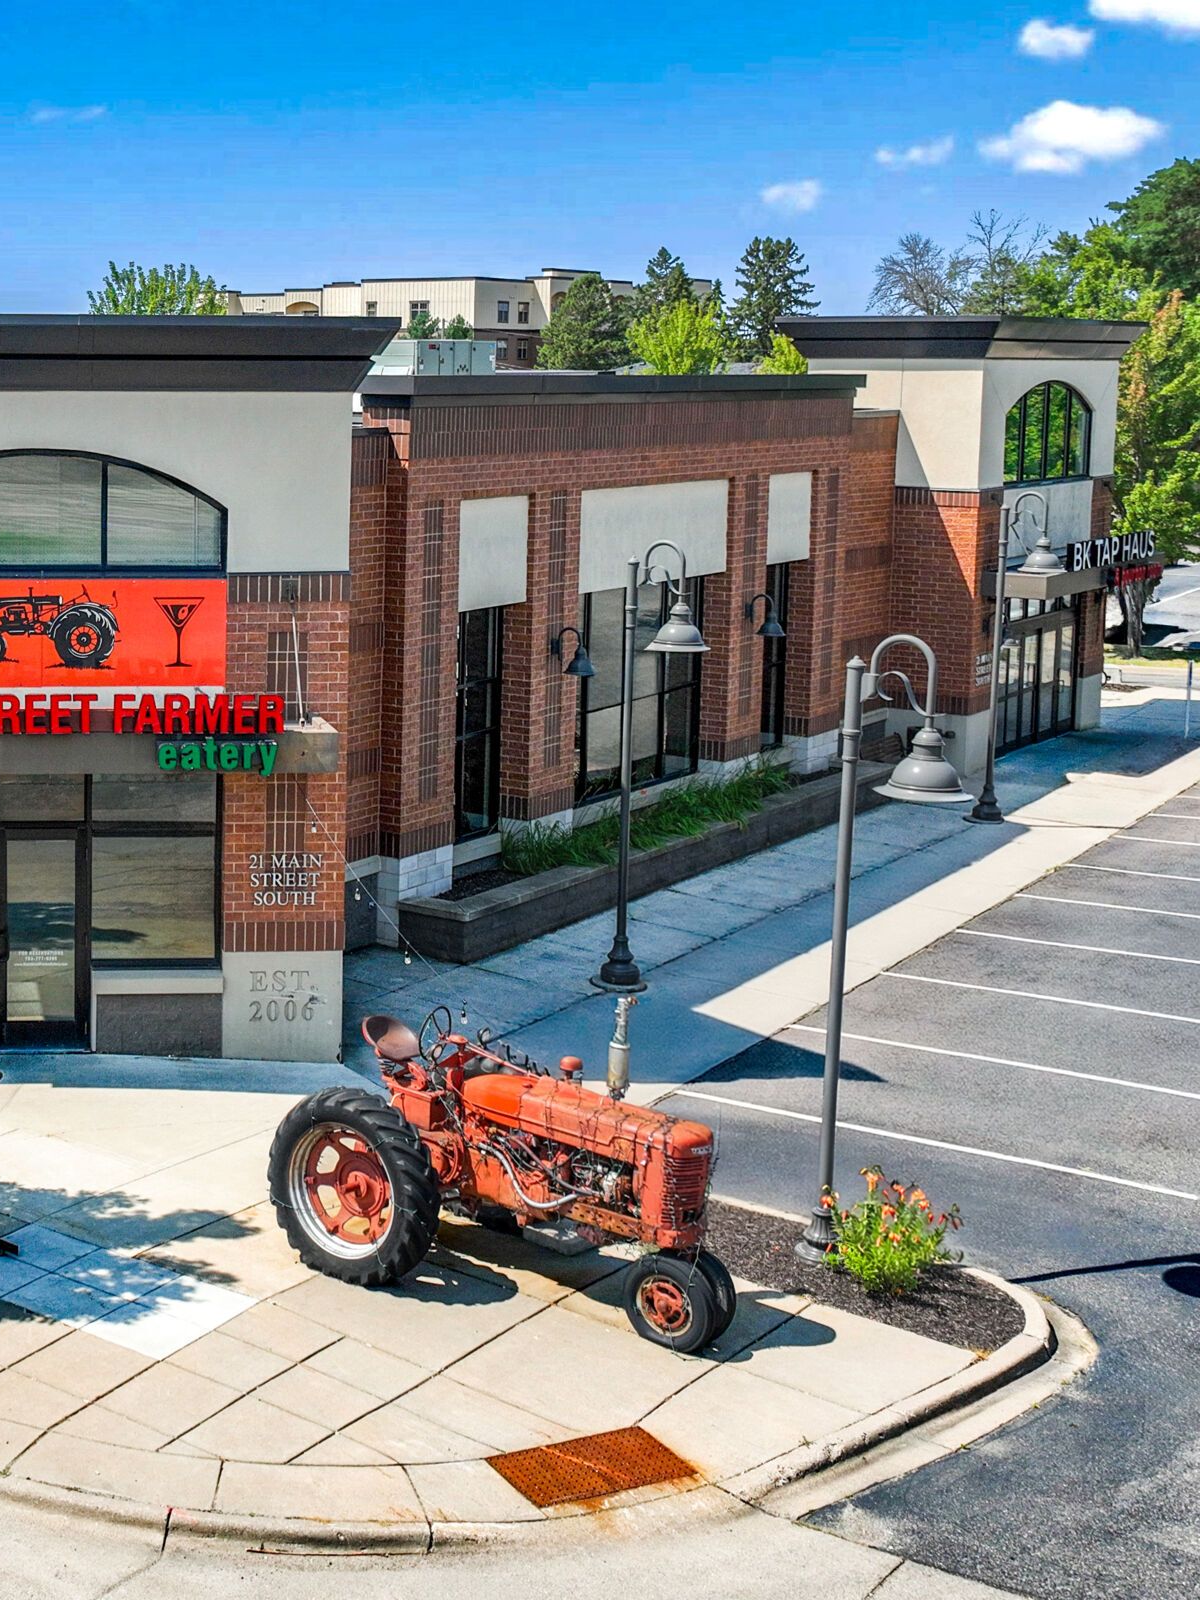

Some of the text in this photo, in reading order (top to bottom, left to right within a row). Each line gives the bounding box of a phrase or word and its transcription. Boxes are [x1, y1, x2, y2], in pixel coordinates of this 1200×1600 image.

[1073, 530, 1155, 572] BK TAP HAUS
[112, 693, 285, 735] FARMER
[157, 738, 279, 776] eatery
[249, 854, 323, 869] 21 MAIN
[250, 872, 320, 887] STREET
[253, 891, 317, 906] SOUTH
[249, 1000, 316, 1022] 2006
